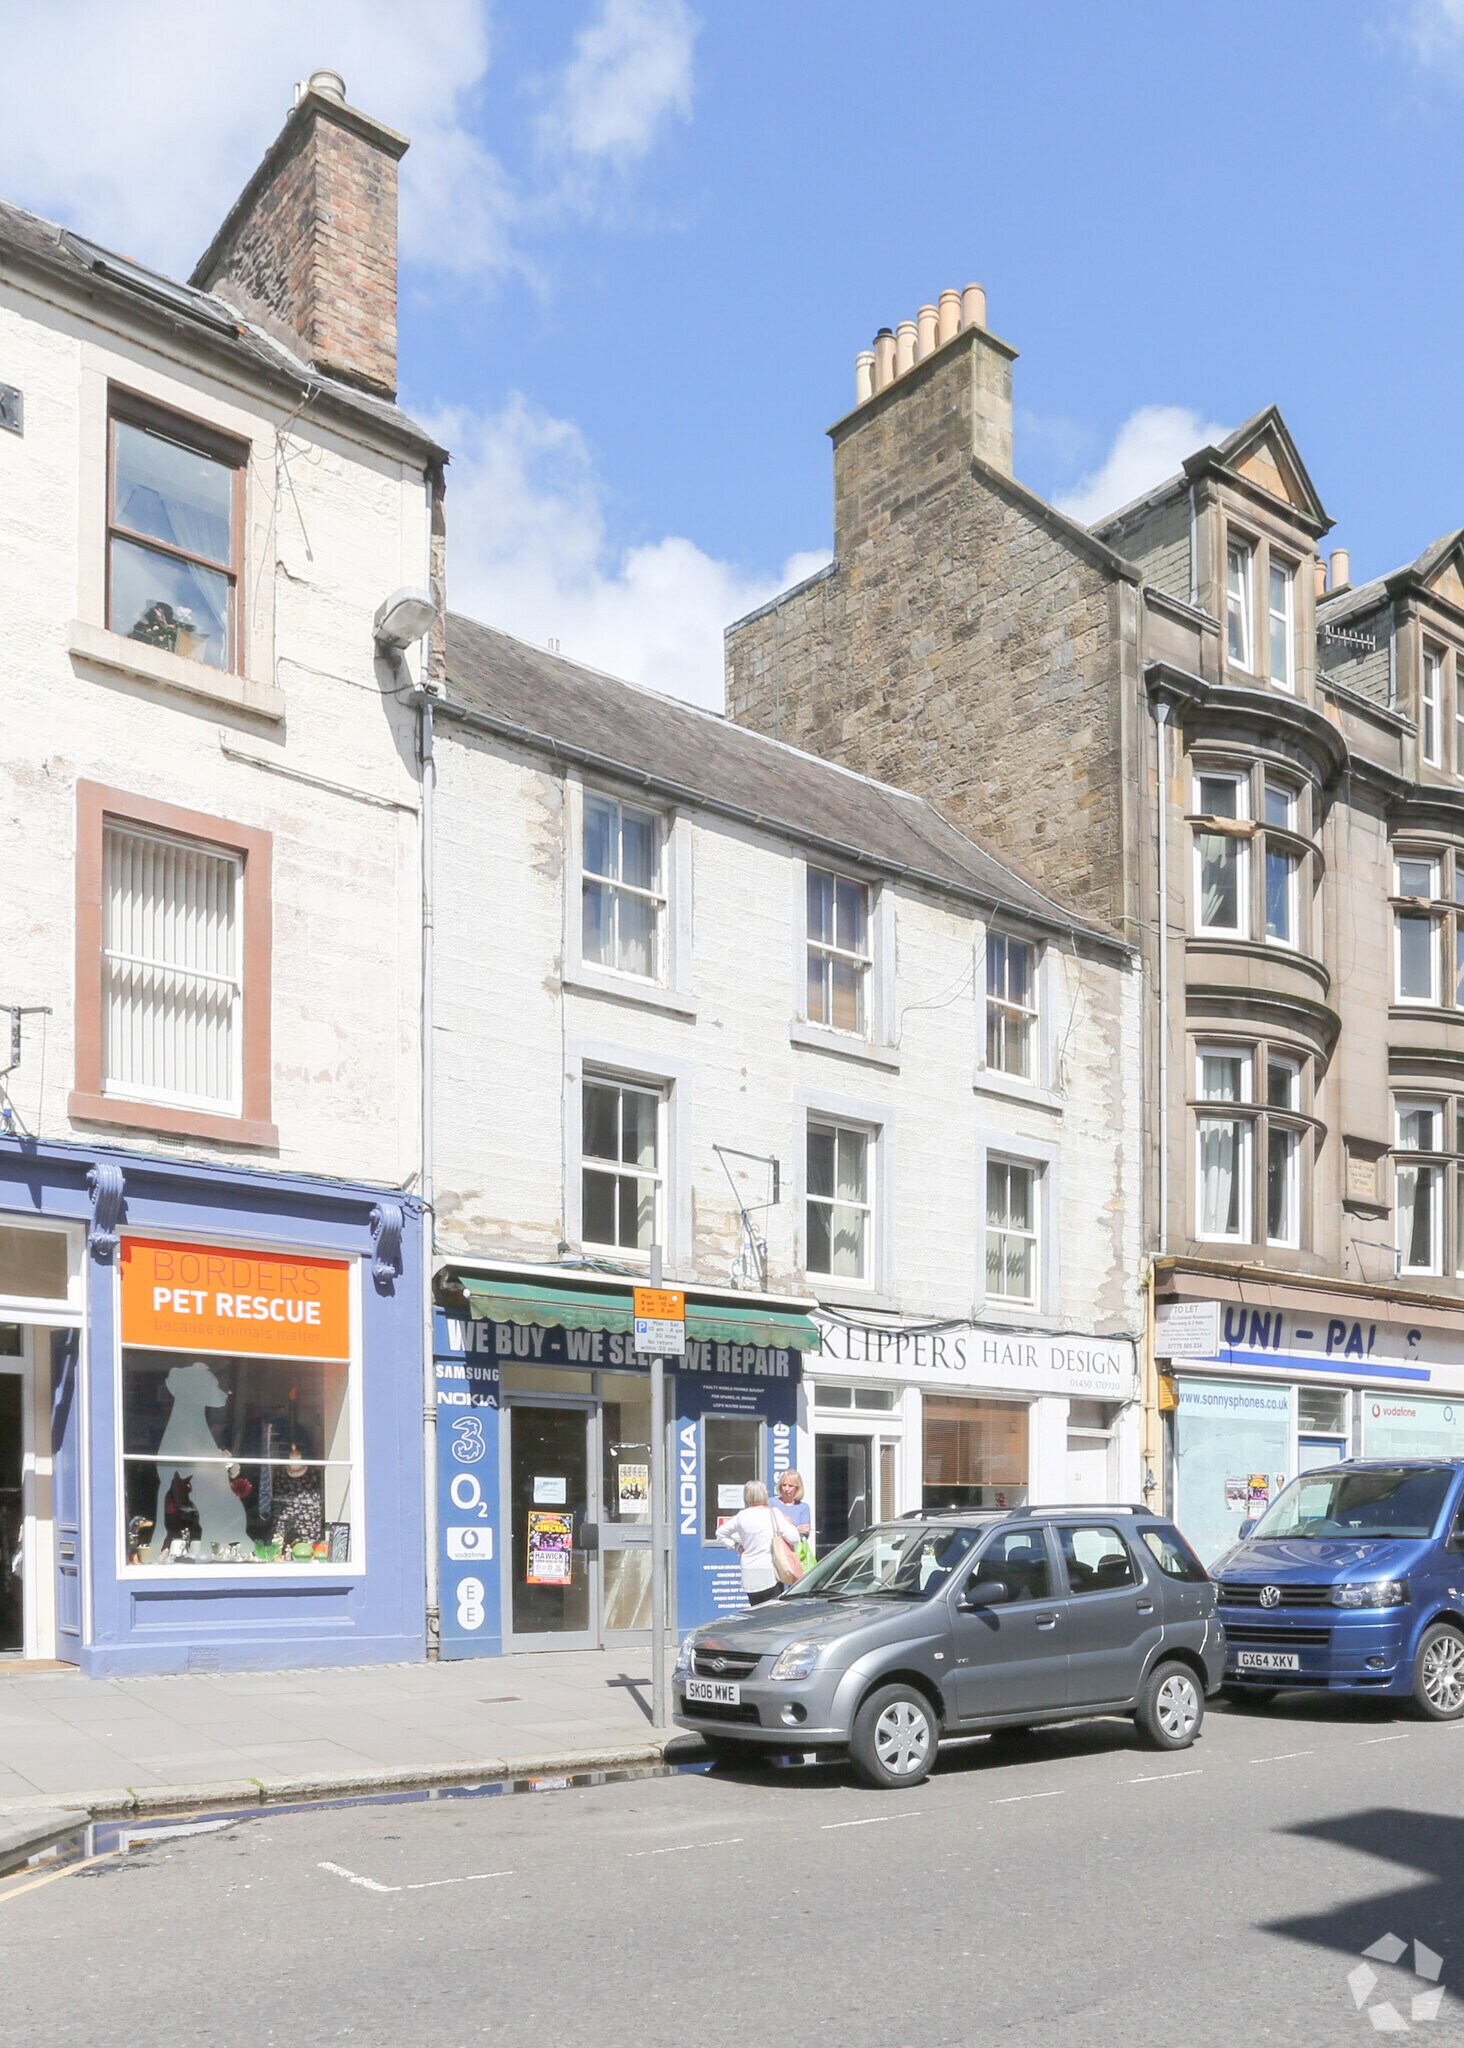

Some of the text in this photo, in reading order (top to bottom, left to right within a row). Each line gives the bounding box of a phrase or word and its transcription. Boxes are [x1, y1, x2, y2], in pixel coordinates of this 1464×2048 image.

[154, 1251, 320, 1295] BORDERS
[153, 1287, 321, 1325] PET RESCUE
[1174, 1304, 1199, 1313] TO LET
[154, 1317, 321, 1343] because animals matter
[1224, 1306, 1283, 1351] UNI
[447, 1319, 489, 1353] WE
[496, 1324, 545, 1357] BUY
[566, 1331, 603, 1362] WE
[679, 1341, 711, 1371] WE
[717, 1345, 789, 1377] REPAIR
[818, 1323, 1121, 1376] KLIPPERS HAIR DESIGN
[436, 1365, 499, 1381] SAMSUNG
[1069, 1378, 1120, 1391] 01450 370920
[437, 1391, 498, 1407] NOKIA
[1382, 1406, 1417, 1417] vodafone
[680, 1423, 698, 1535] NOKIA
[534, 1523, 568, 1534] CIRCUS
[454, 1551, 486, 1559] vodafone
[535, 1551, 564, 1560] HAWICK
[1242, 1653, 1294, 1668] GX64 XKV
[689, 1682, 735, 1702] SK06 MWE
